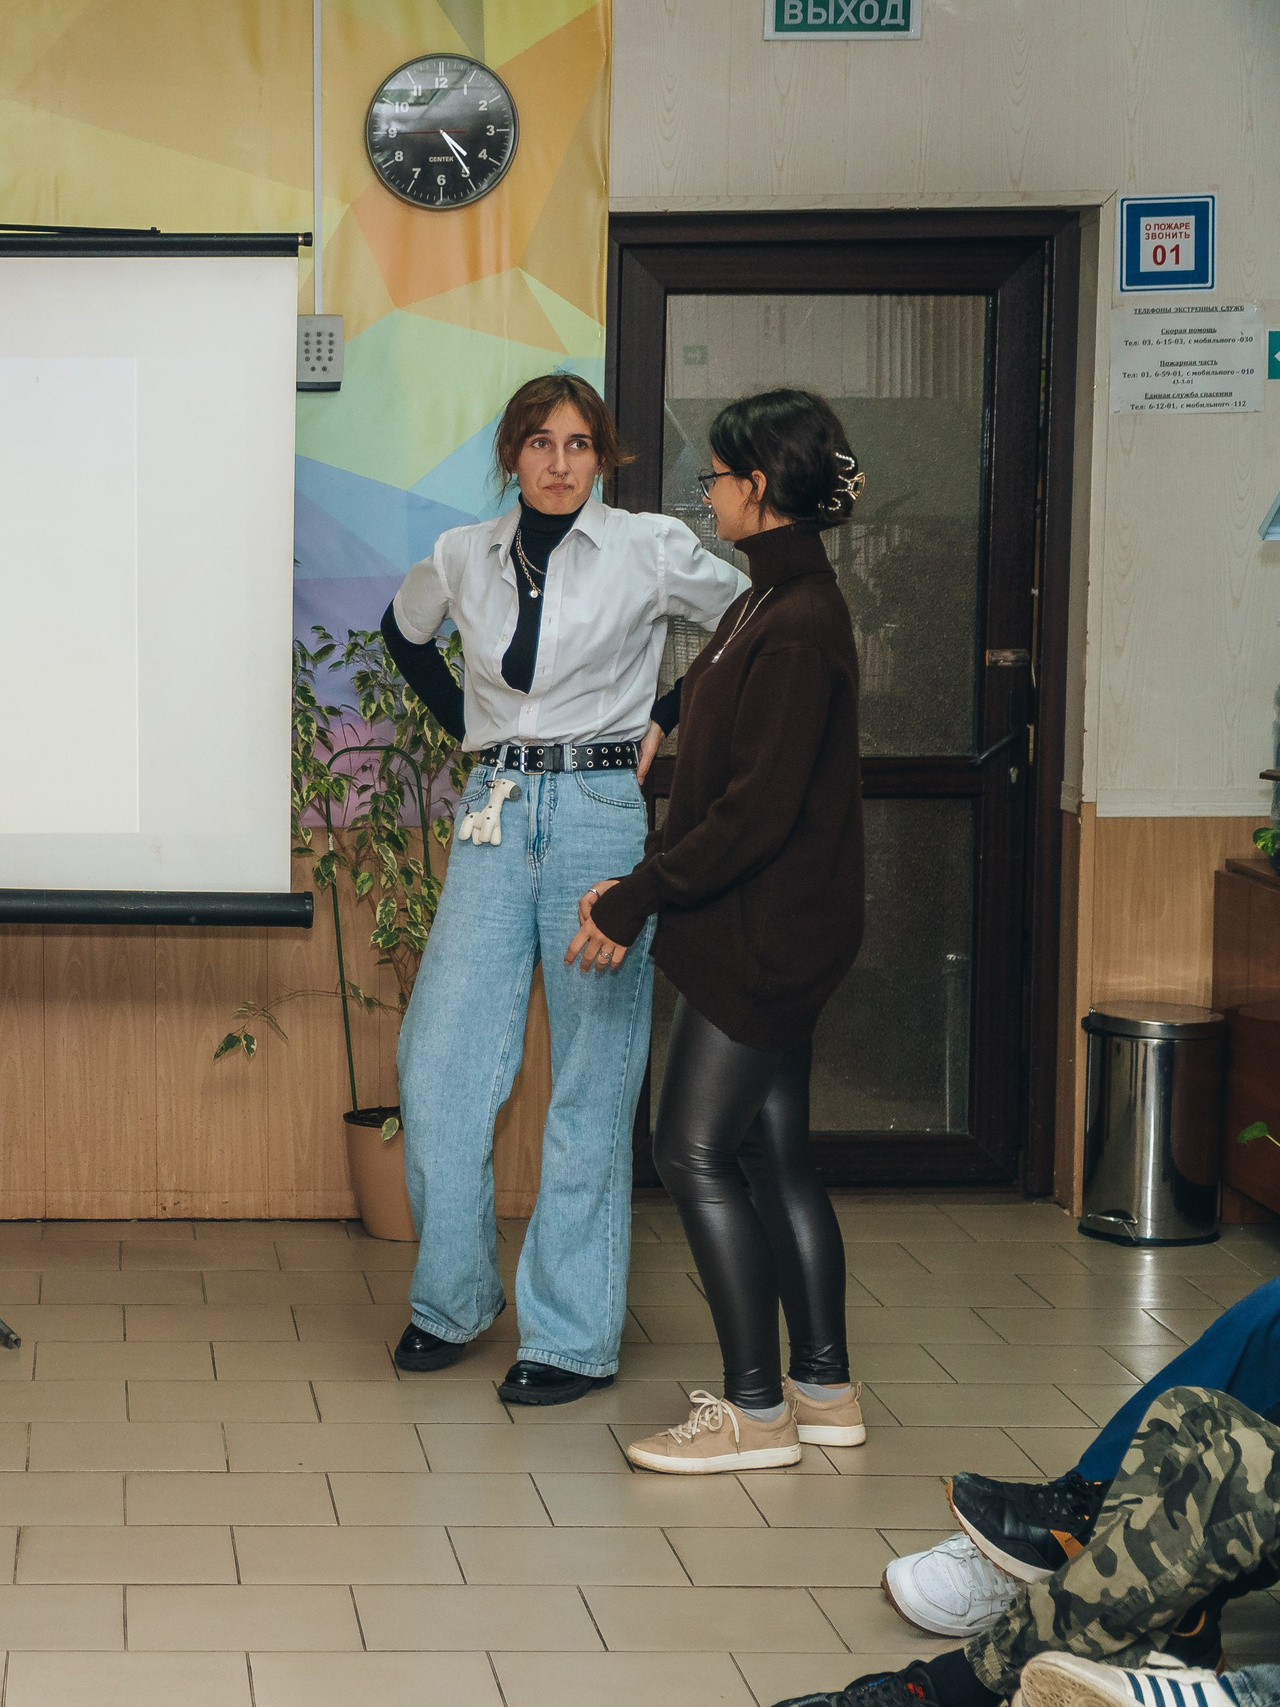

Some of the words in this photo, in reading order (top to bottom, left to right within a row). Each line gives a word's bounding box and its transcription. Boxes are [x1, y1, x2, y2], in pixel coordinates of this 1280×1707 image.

[783, 0, 905, 26] ВЫХОД
[434, 77, 448, 89] 12
[412, 85, 422, 96] 11
[463, 84, 468, 95] 1
[394, 102, 410, 113] 10
[478, 100, 488, 111] 2
[388, 127, 397, 138] 9
[486, 125, 495, 136] 3
[394, 151, 404, 162] 8
[478, 149, 488, 160] 4
[412, 168, 421, 179] 7
[437, 175, 446, 186] 6
[1145, 223, 1151, 231] О
[1153, 222, 1190, 231] ПОЖАРЕ
[1144, 231, 1190, 240] ЗВОНИТЬ
[1152, 244, 1180, 266] 01
[1133, 307, 1172, 315] ТЕЛЕФОНЫ
[1144, 392, 1171, 400] Единая
[1171, 391, 1199, 399] служба
[1200, 390, 1233, 398] спасения
